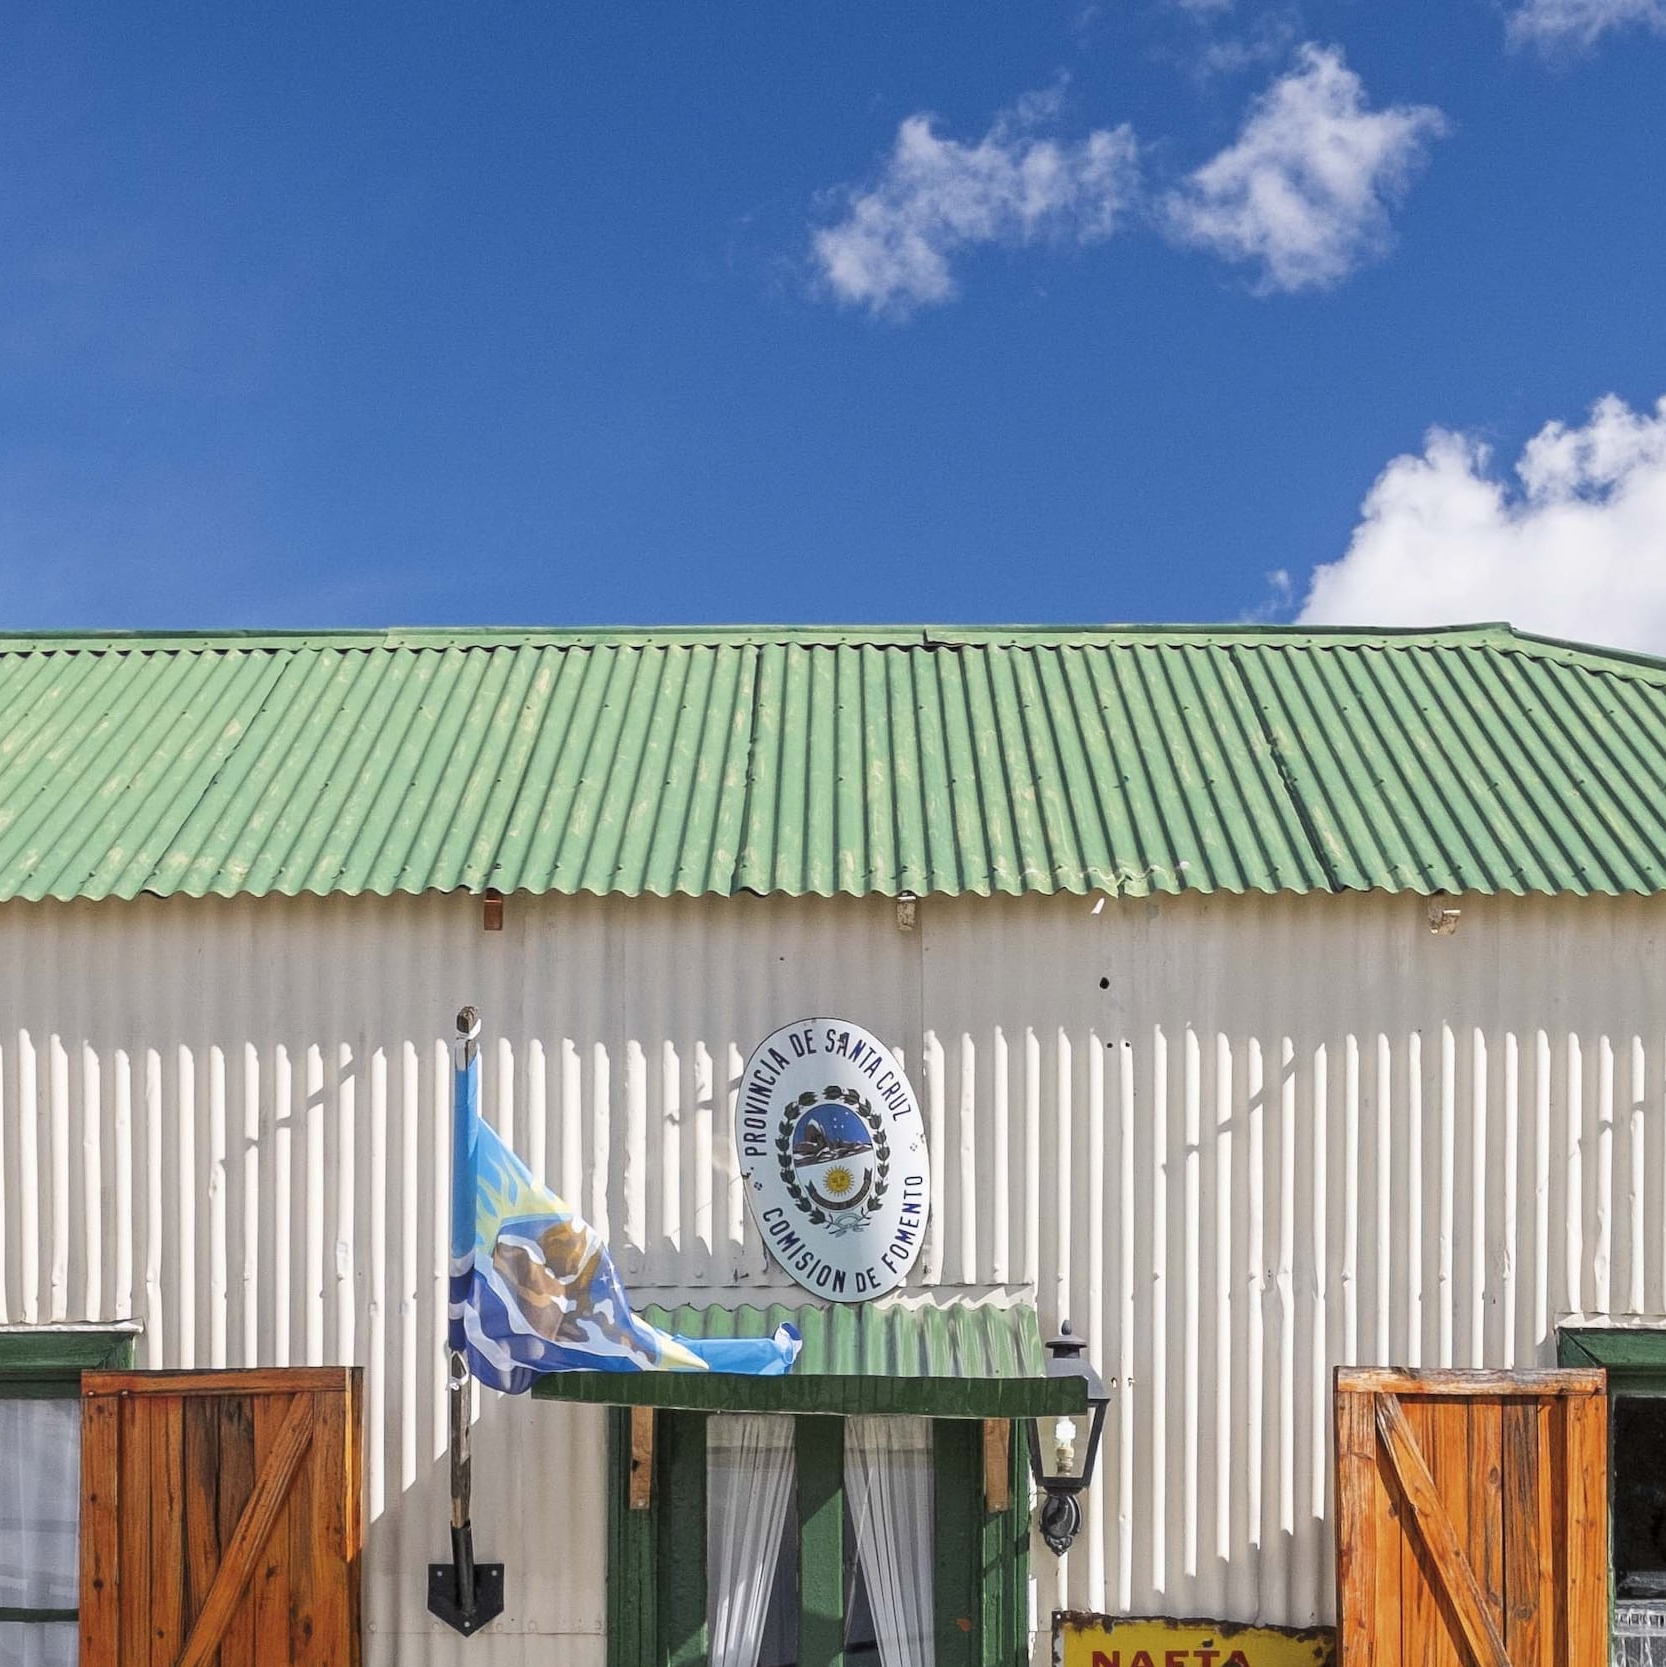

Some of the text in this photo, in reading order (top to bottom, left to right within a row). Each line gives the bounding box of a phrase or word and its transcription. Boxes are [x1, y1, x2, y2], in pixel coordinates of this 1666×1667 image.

[744, 1029, 911, 1157] PROVINCIA DE SANTA CRUZ
[762, 1175, 923, 1293] COMISION DE FOMENTO
